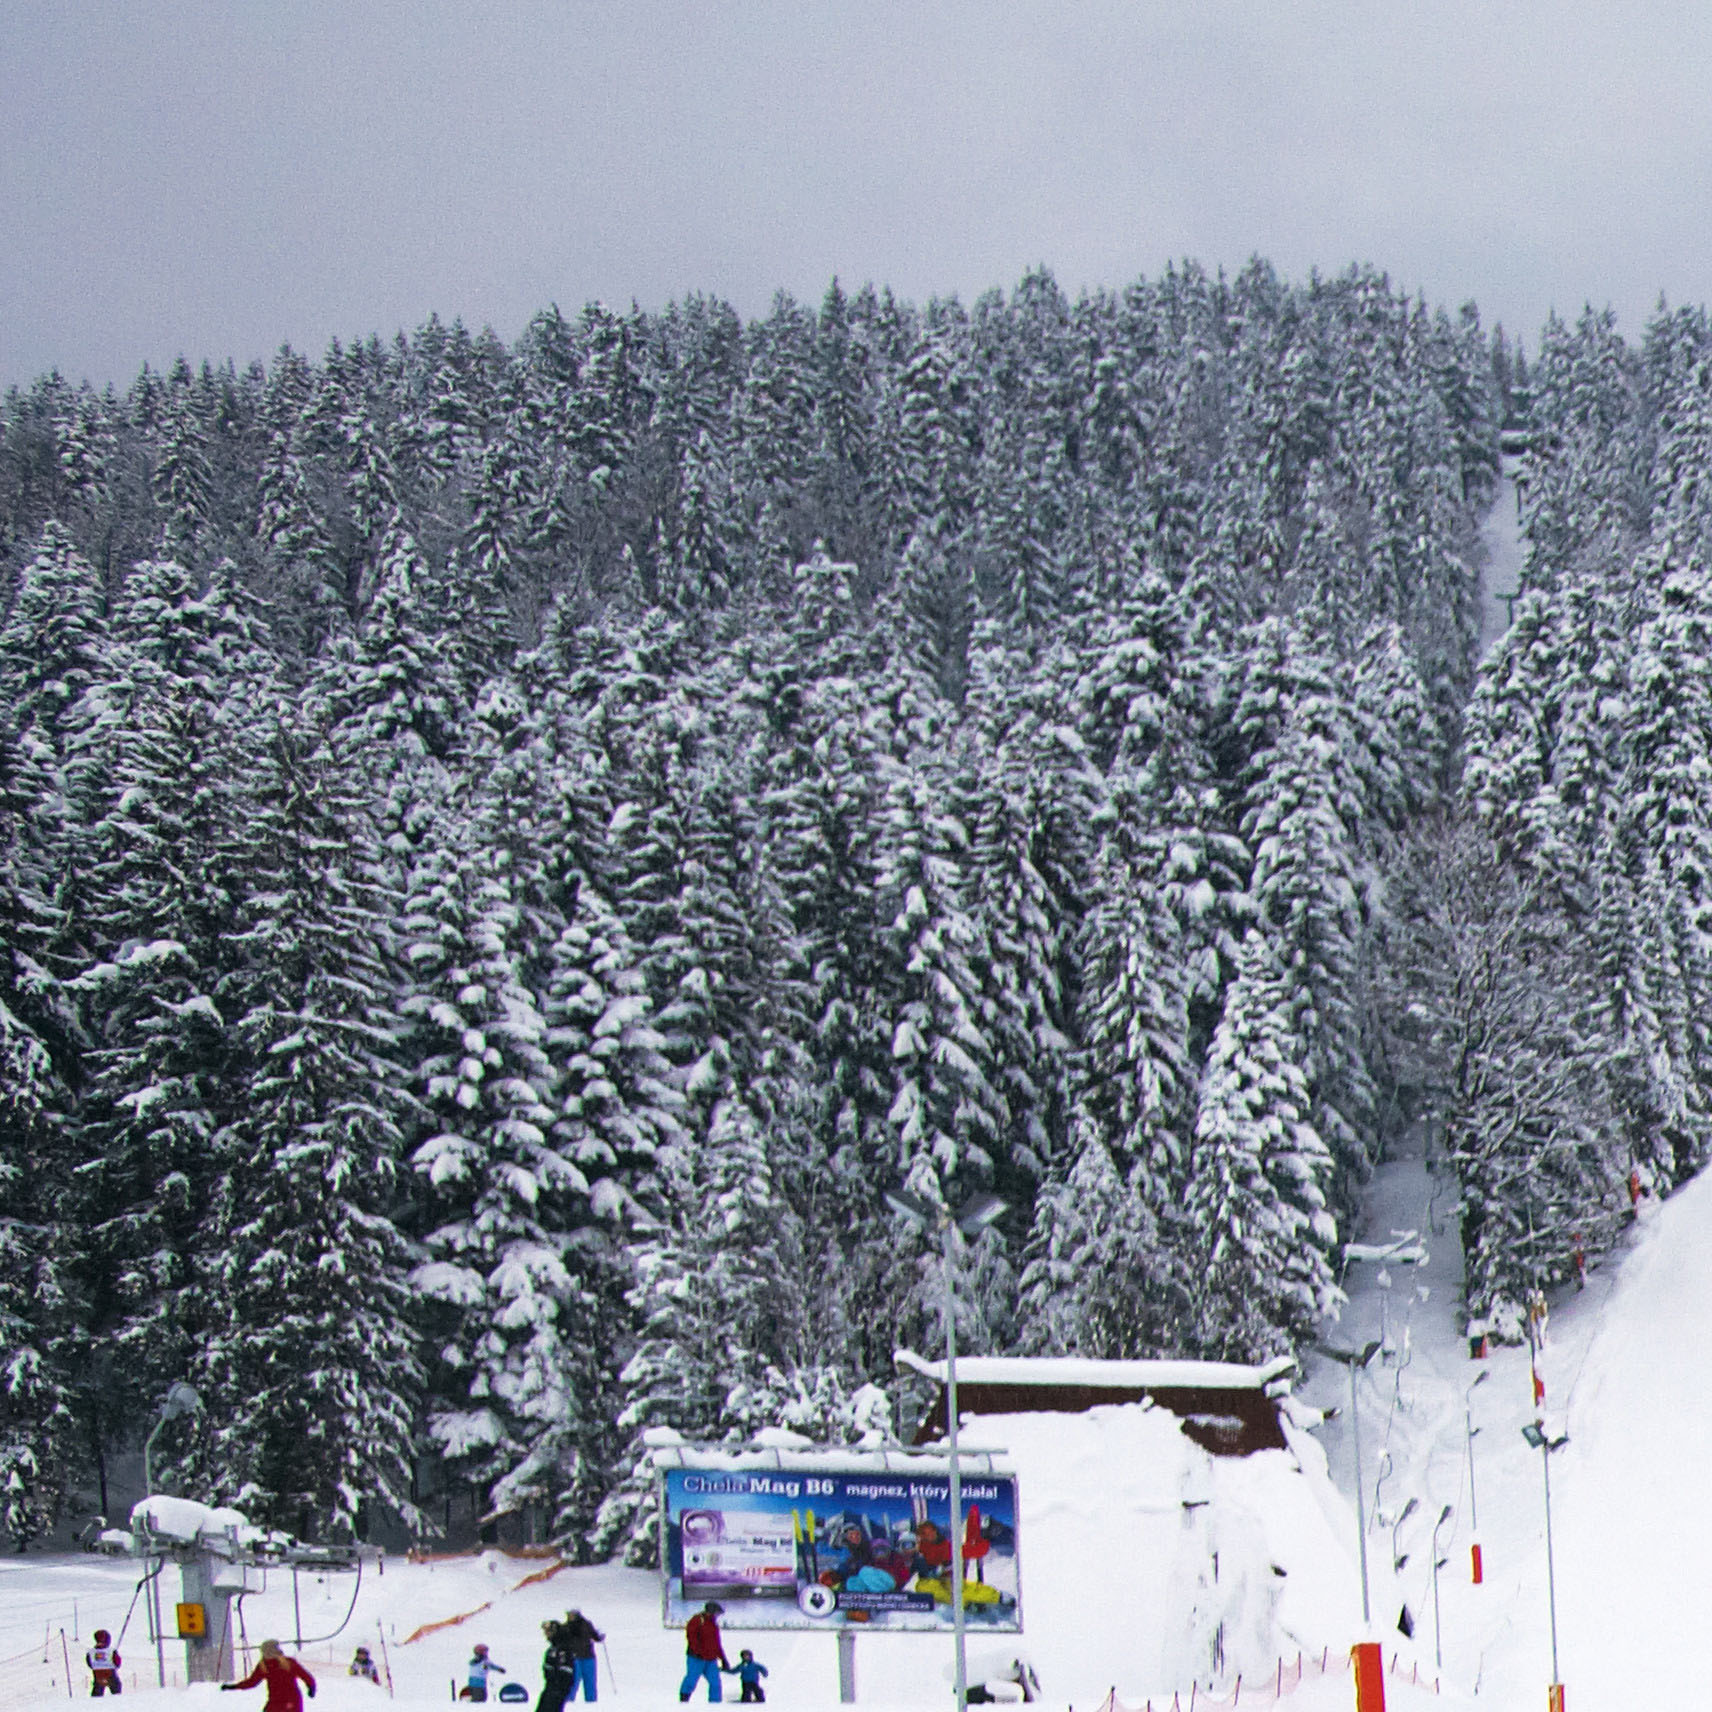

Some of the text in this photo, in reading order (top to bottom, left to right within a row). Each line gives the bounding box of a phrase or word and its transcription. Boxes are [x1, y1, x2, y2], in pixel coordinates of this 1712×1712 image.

[750, 1478, 800, 1498] Mag
[806, 1479, 834, 1495] B6
[846, 1482, 998, 1502] magnez, który ziała!
